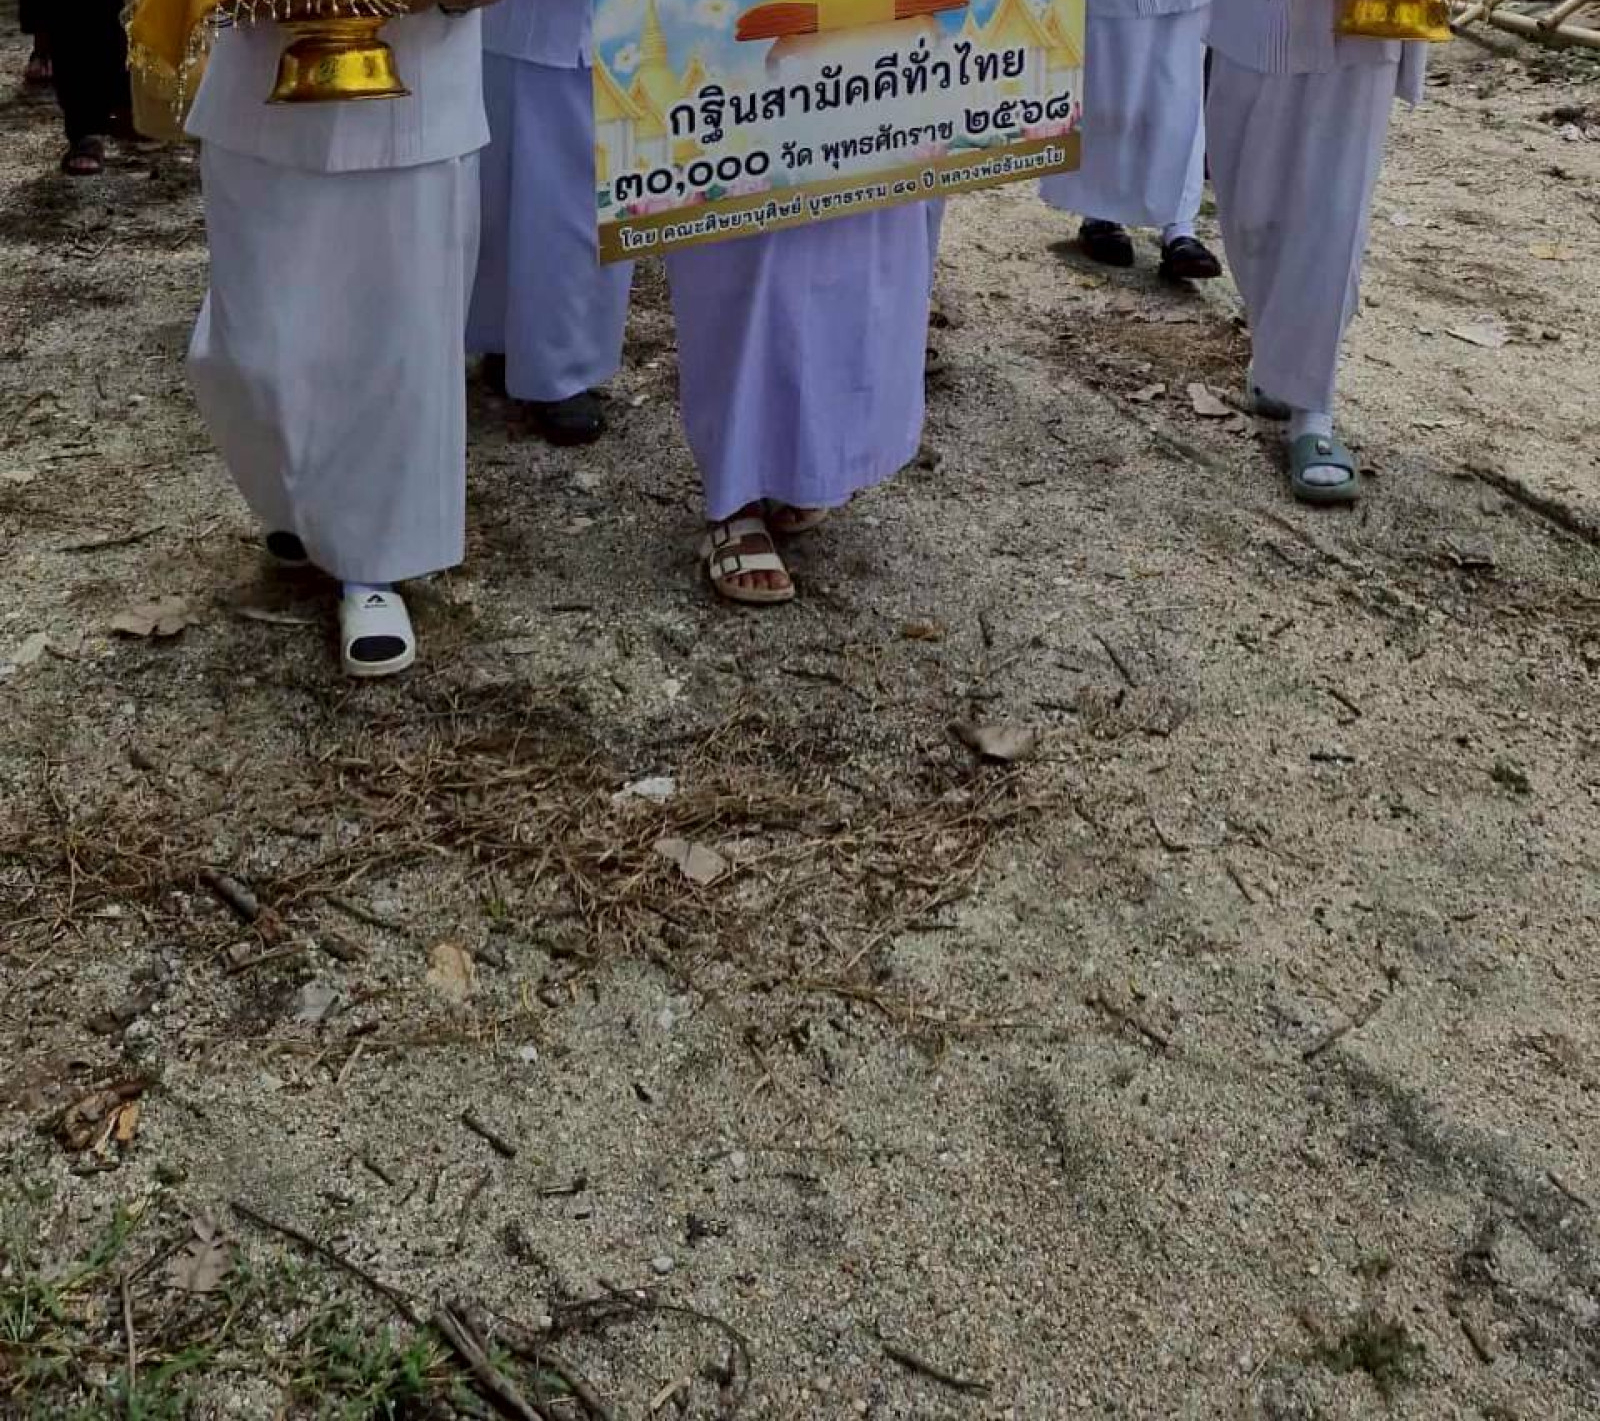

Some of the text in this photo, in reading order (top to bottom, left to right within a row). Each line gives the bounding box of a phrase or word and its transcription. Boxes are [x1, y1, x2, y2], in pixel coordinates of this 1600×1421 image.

[670, 37, 1025, 144] กฐินสามัคคีทั่วไทย
[614, 91, 1071, 202] ๓๐,๐๐๐ วัด พุทธศักราช ๒๕๖๘
[620, 228, 656, 249] โดย
[809, 184, 887, 216] บูชาธรรม
[922, 169, 935, 189] ปี
